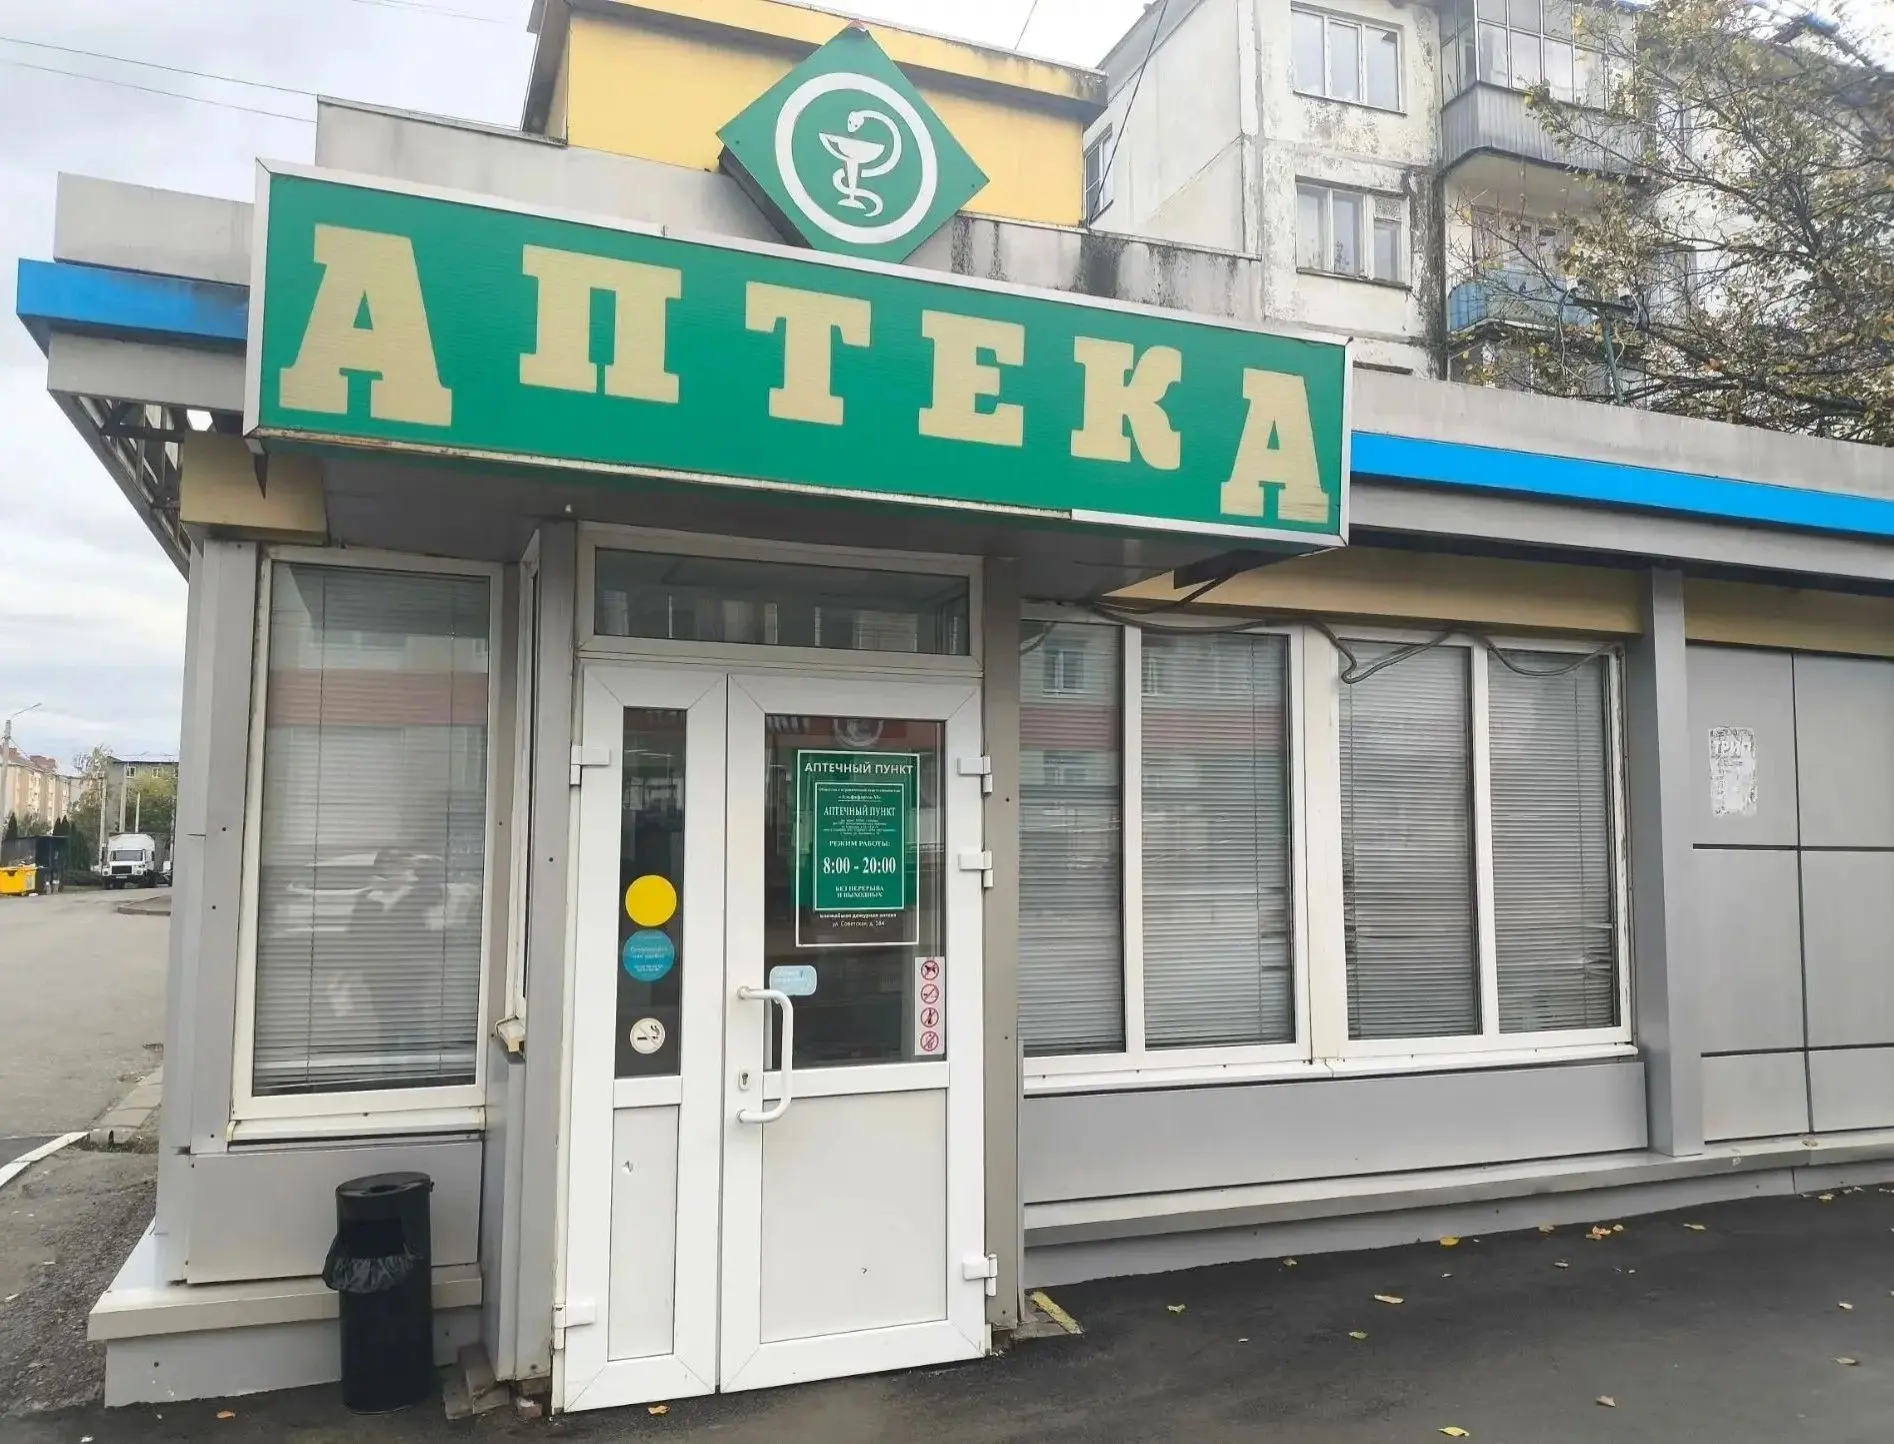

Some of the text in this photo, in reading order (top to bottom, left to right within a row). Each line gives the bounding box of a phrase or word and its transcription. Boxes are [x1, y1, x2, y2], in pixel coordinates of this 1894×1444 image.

[279, 224, 1330, 524] АПТЕКА
[804, 761, 914, 775] АПТЕЧНЫЙ ПУНКТ
[823, 805, 896, 817] АПТЕЧНЫЙ ПУНКТ
[829, 840, 891, 848] РЕЖИМ РАБОТЫ:
[823, 856, 850, 874] 8:00
[862, 856, 896, 874] 20:00
